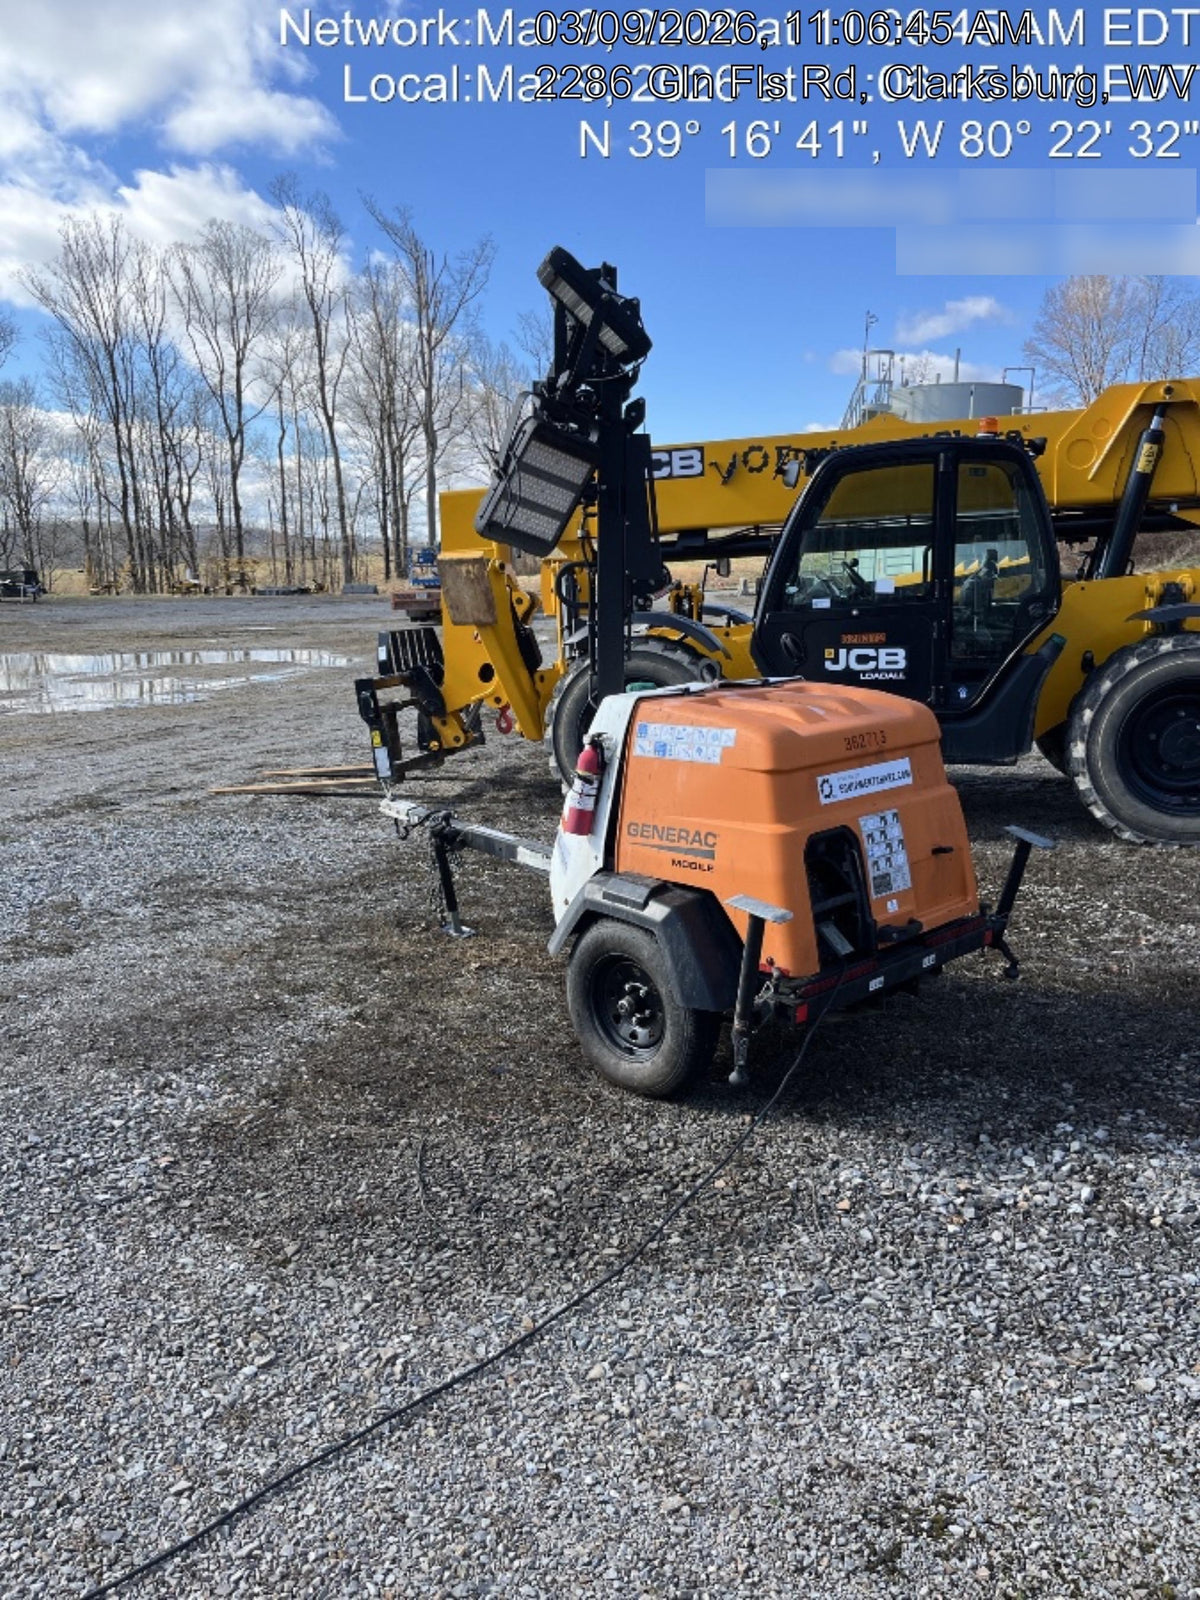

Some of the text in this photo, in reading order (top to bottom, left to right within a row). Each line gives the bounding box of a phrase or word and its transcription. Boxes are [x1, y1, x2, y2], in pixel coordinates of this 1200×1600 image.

[645, 449, 704, 479] CB
[824, 648, 907, 671] JCB
[860, 672, 906, 680] LOADALL
[627, 822, 718, 848] GENERAC
[671, 859, 714, 873] MOBILE
